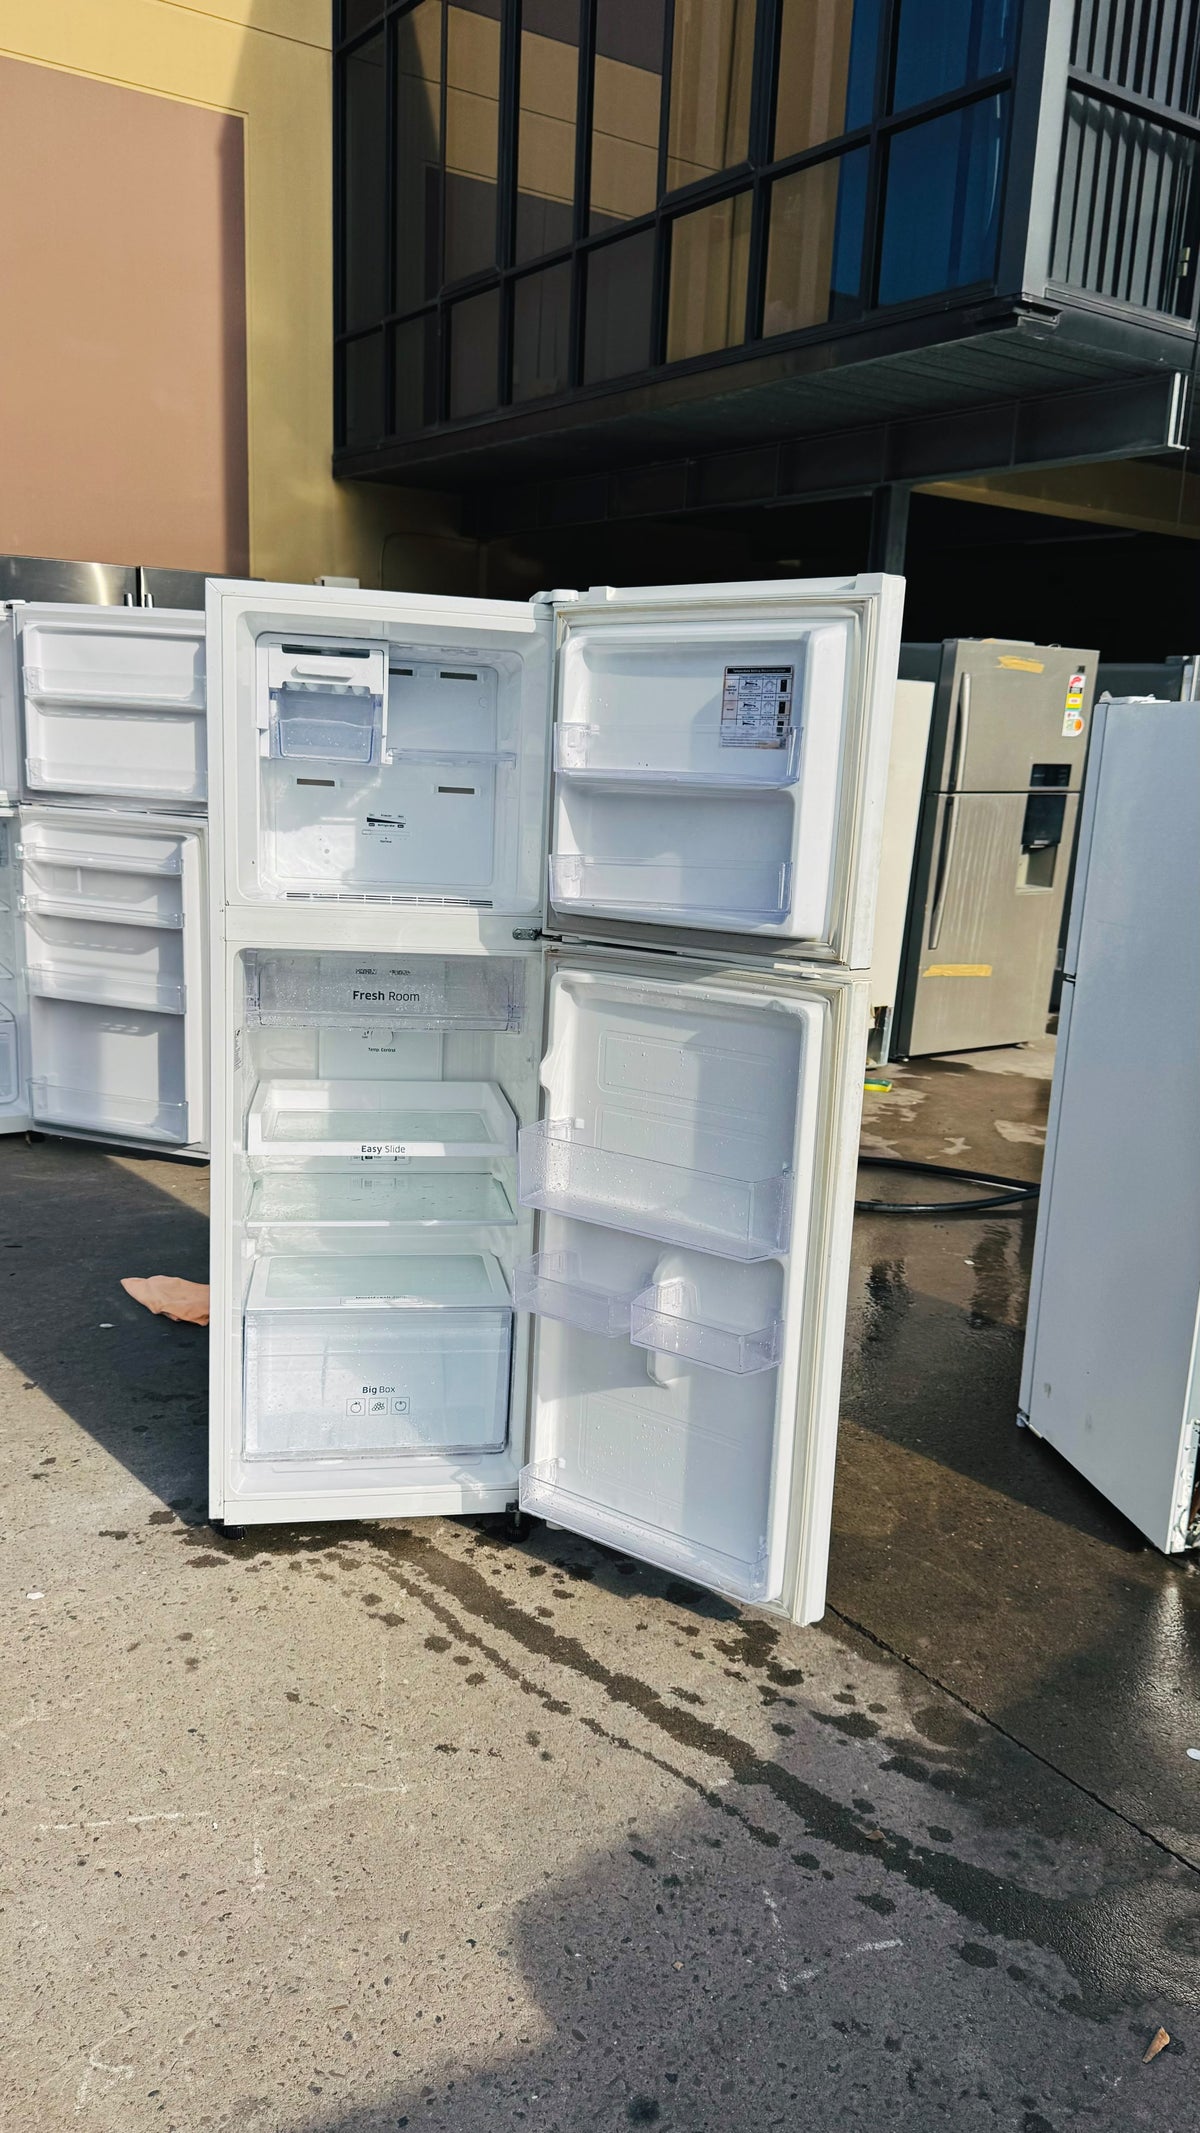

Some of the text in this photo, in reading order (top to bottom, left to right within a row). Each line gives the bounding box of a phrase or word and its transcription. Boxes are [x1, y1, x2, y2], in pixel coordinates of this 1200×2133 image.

[353, 990, 420, 1001] Fresh Room
[361, 1145, 406, 1154] Easy Slide
[362, 1385, 396, 1395] Big Box
